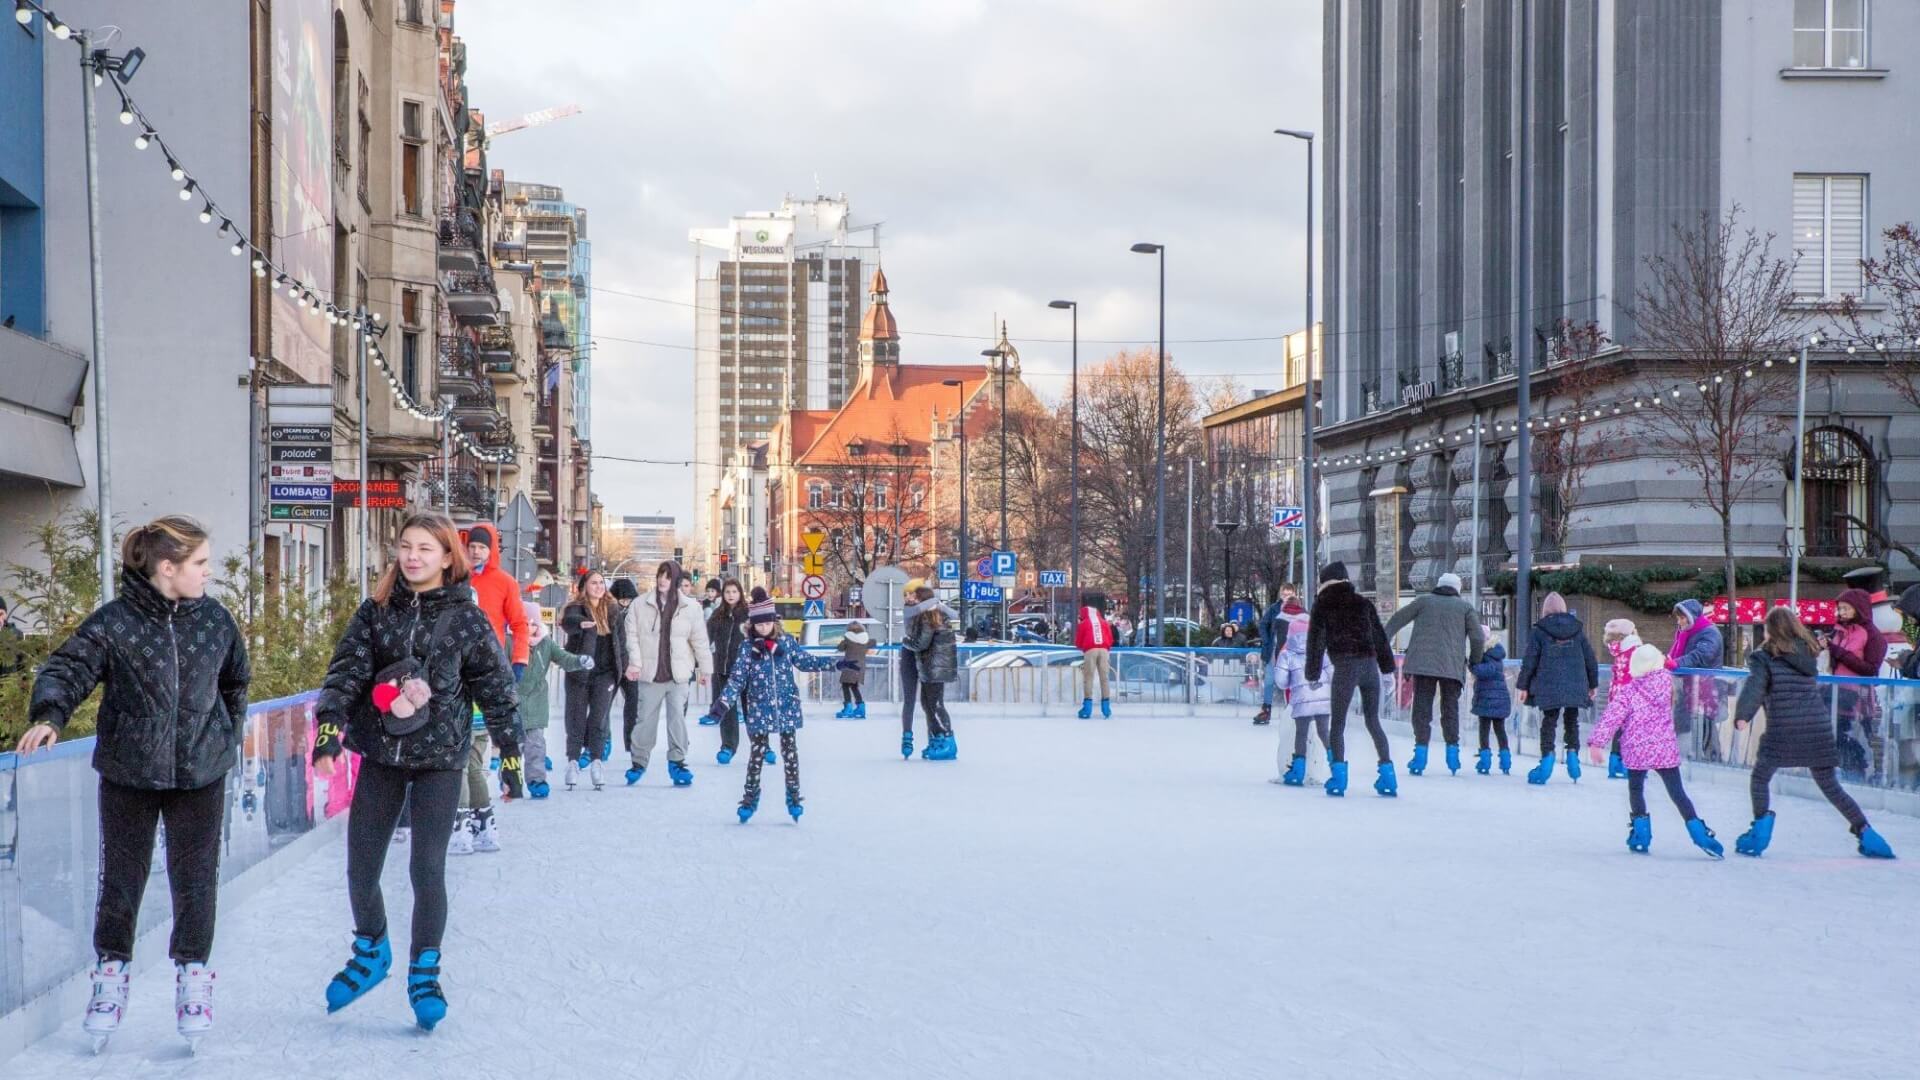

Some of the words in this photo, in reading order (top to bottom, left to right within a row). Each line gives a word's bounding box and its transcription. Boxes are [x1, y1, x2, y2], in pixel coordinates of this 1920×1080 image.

[280, 448, 317, 460] polcode
[274, 487, 328, 497] LOMBARD
[998, 555, 1011, 573] P
[943, 562, 955, 578] P
[1042, 573, 1066, 584] TAXI
[980, 587, 1000, 597] BUS
